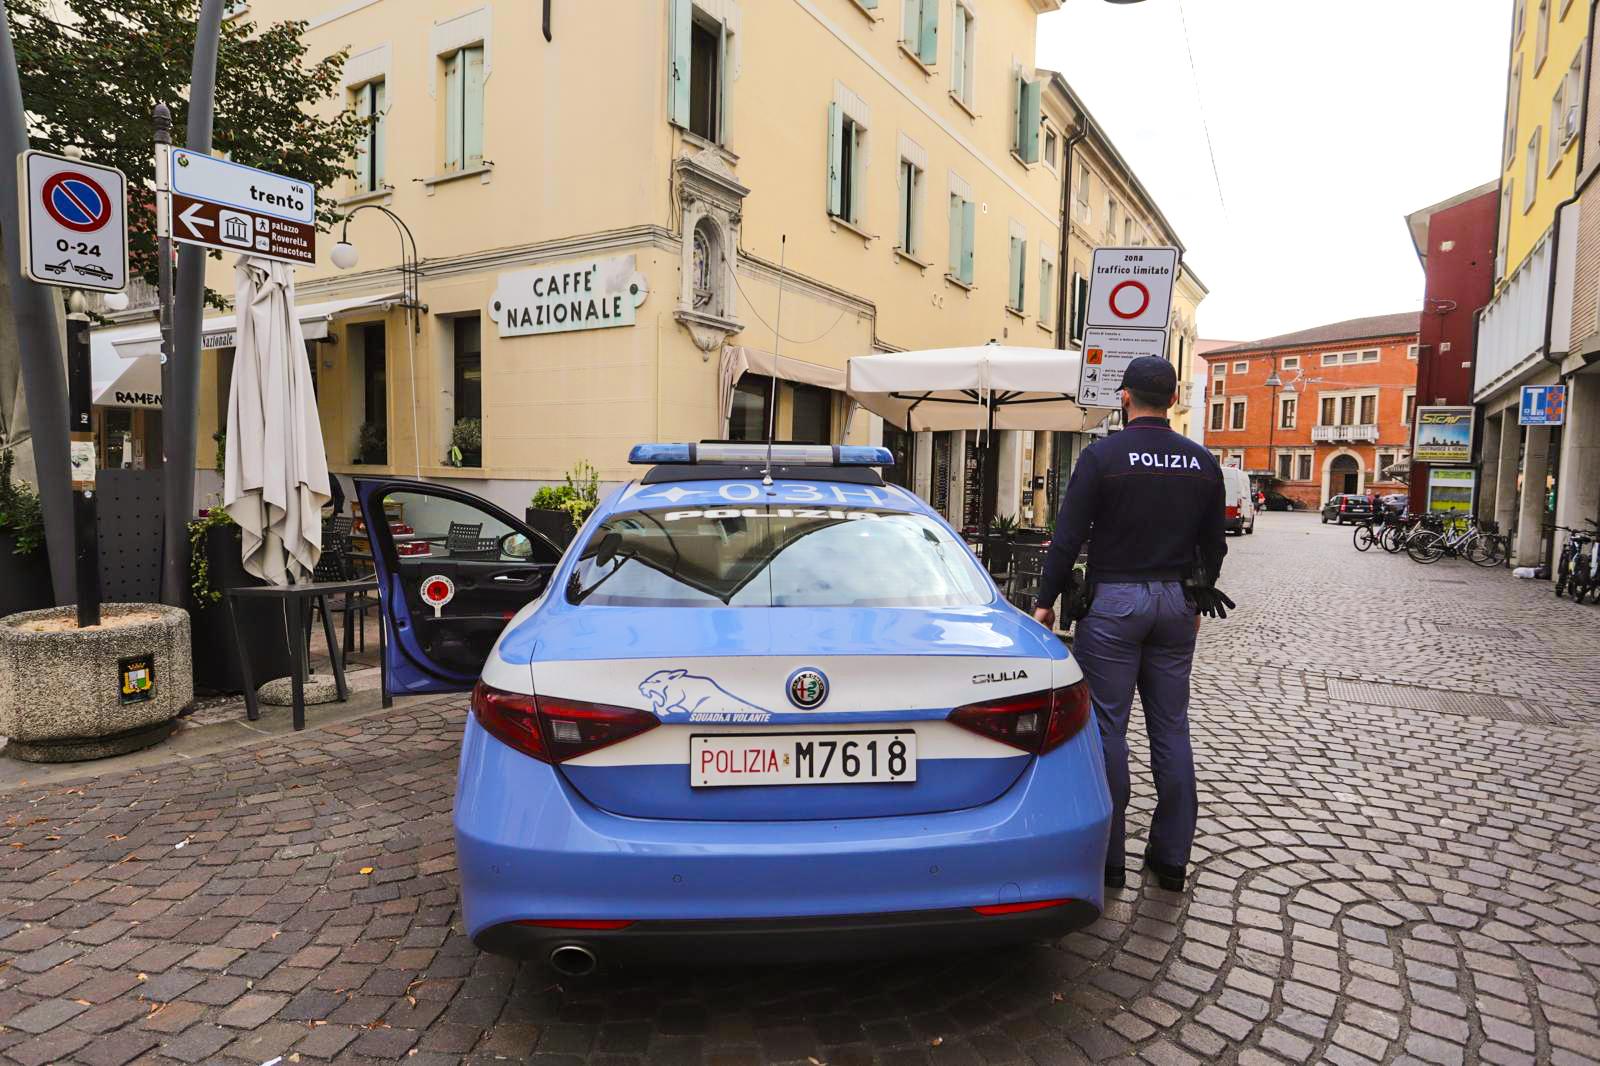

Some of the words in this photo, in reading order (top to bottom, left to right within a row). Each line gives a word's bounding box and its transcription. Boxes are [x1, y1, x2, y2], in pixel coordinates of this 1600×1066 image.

[291, 185, 304, 194] via
[250, 185, 304, 211] trento
[271, 221, 299, 234] palazzo
[271, 232, 308, 247] Roverella
[56, 238, 102, 257] 0-24
[271, 244, 312, 259] pinacoteca
[1097, 265, 1131, 274] traffico
[1133, 265, 1169, 275] limitato
[507, 296, 622, 328] NAZIONALE
[115, 391, 163, 405] RAMEN
[1128, 452, 1201, 470] POLIZIA
[972, 669, 1028, 684] GIULIA
[732, 713, 771, 723] VOLANTE
[701, 749, 780, 775] POLIZIA
[794, 738, 907, 778] M7618
